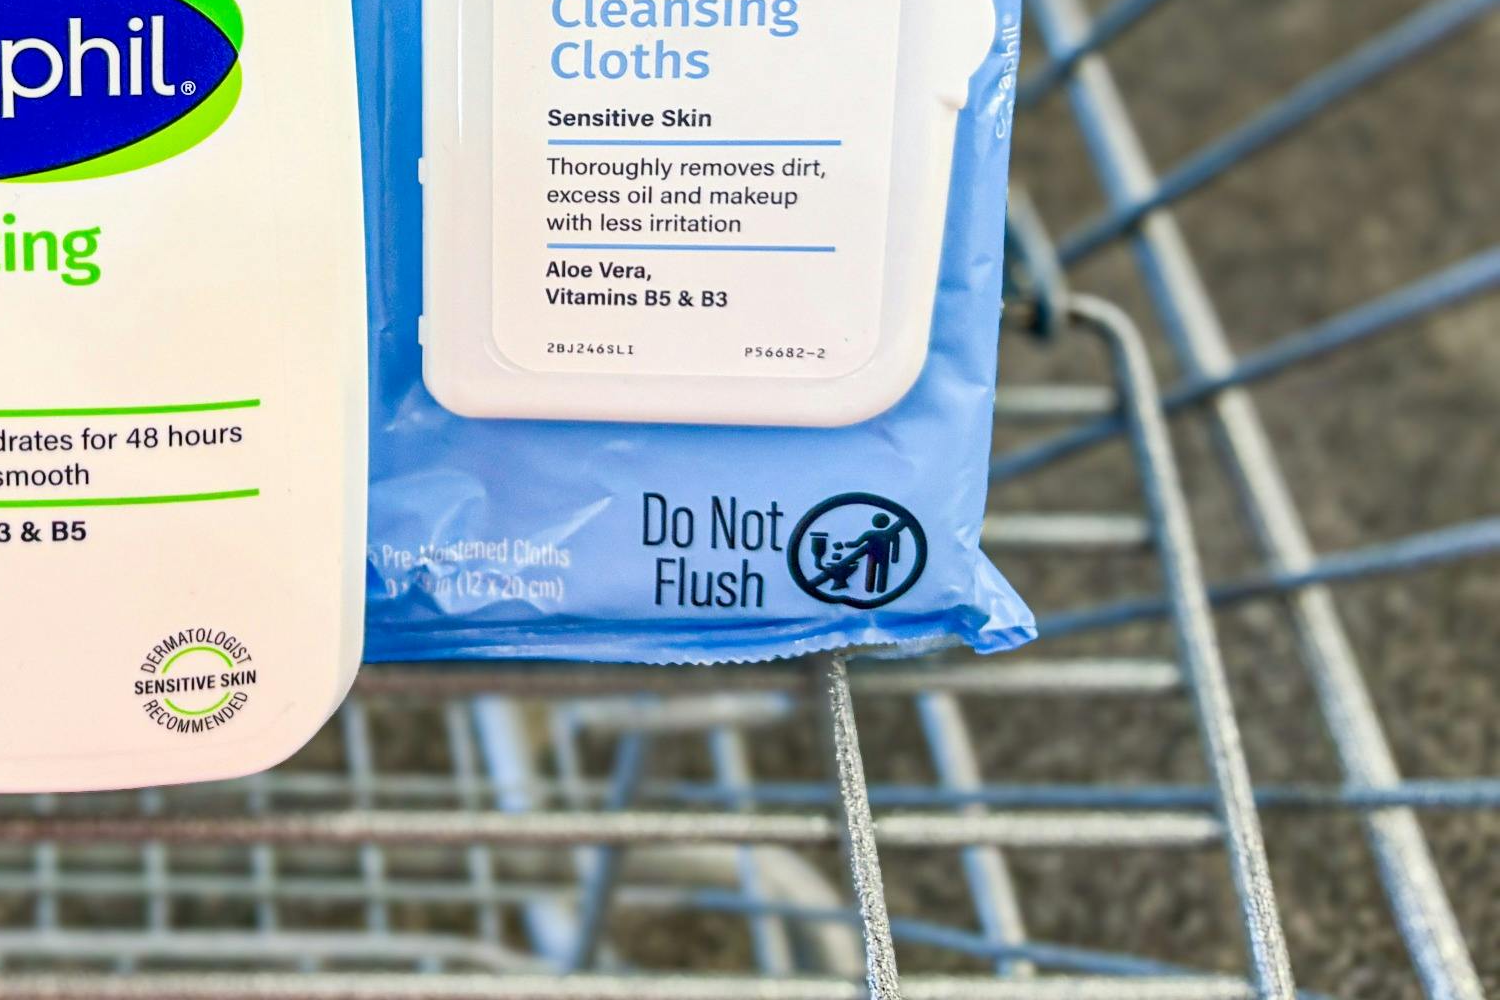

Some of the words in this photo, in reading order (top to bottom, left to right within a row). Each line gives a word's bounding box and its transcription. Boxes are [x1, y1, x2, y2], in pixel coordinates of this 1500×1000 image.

[551, 40, 710, 79] Cloths
[548, 109, 654, 126] Sensitive
[662, 109, 711, 126] Skin
[547, 157, 672, 180] Thoroughly
[681, 163, 774, 176] removes
[782, 158, 825, 178] dirt,
[547, 190, 620, 203] excess
[628, 186, 652, 203] oil
[661, 186, 701, 204] and
[710, 187, 797, 209] makeup
[547, 213, 591, 230] with
[601, 214, 642, 231] less
[651, 214, 740, 232] irritation
[546, 261, 592, 278] Aloe
[599, 262, 651, 281] Vera,
[546, 288, 637, 305] Vitamins
[645, 290, 670, 306] B5
[678, 291, 693, 306] &
[702, 291, 727, 307] B3
[745, 347, 825, 358] P56682-2
[82, 428, 117, 450] for
[127, 428, 158, 448] 48
[169, 425, 242, 447] hours
[21, 522, 41, 542] &
[52, 521, 86, 541] B5
[643, 493, 693, 548] Do
[711, 496, 783, 551] Not
[513, 539, 571, 568] Cloths
[655, 557, 763, 608] Flush
[141, 628, 251, 673] DERMATOLOGIST
[135, 675, 215, 695] SENSITIVE
[221, 670, 256, 687] SKIN
[144, 692, 247, 733] RECOMMENDED
